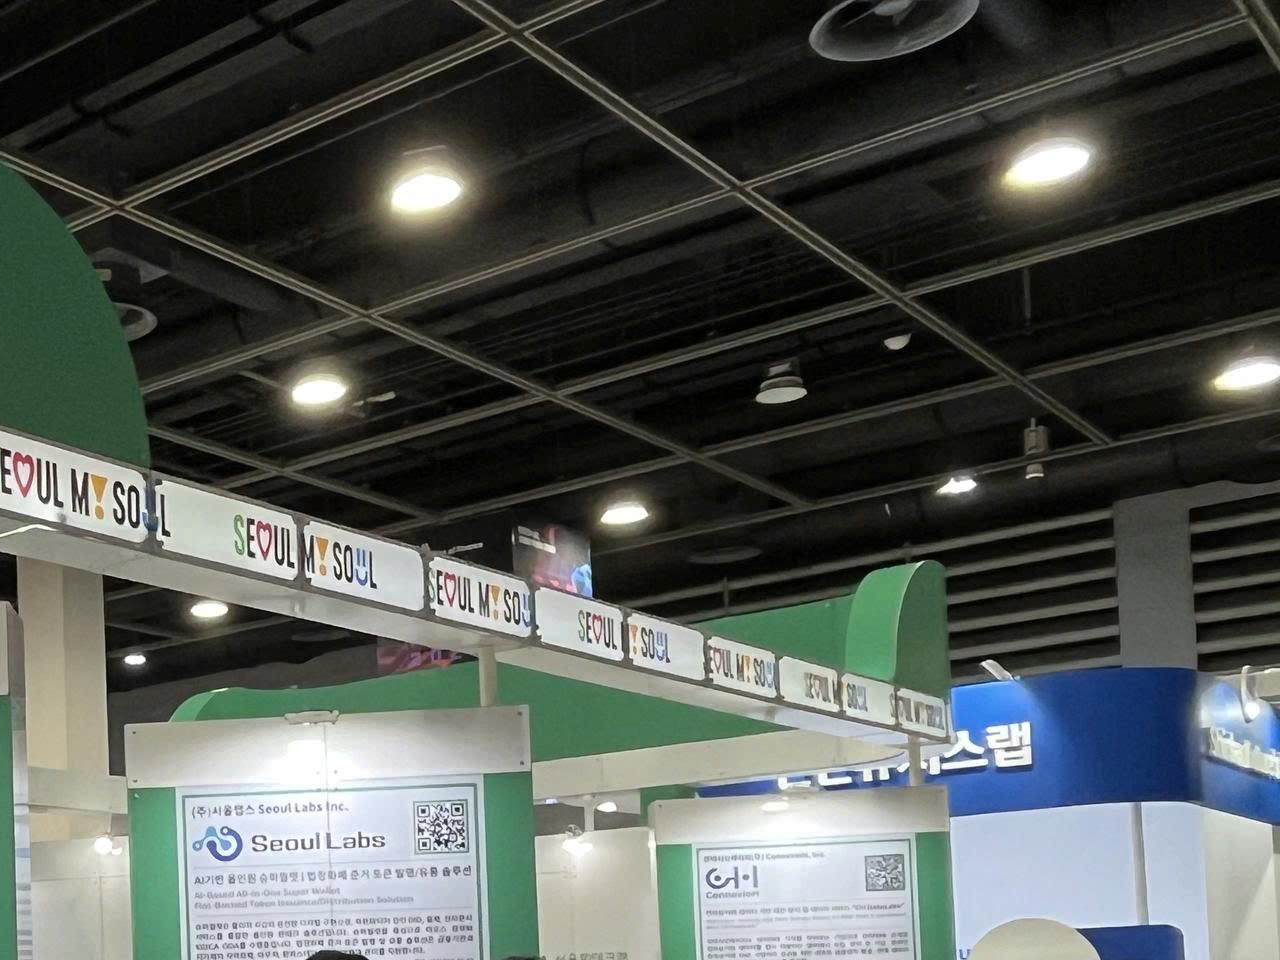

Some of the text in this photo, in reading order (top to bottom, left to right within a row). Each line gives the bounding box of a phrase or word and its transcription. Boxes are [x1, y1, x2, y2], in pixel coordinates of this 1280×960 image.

[258, 803, 293, 814] Seoul
[295, 802, 323, 813] Labs
[251, 831, 386, 852] Seoul Labs
